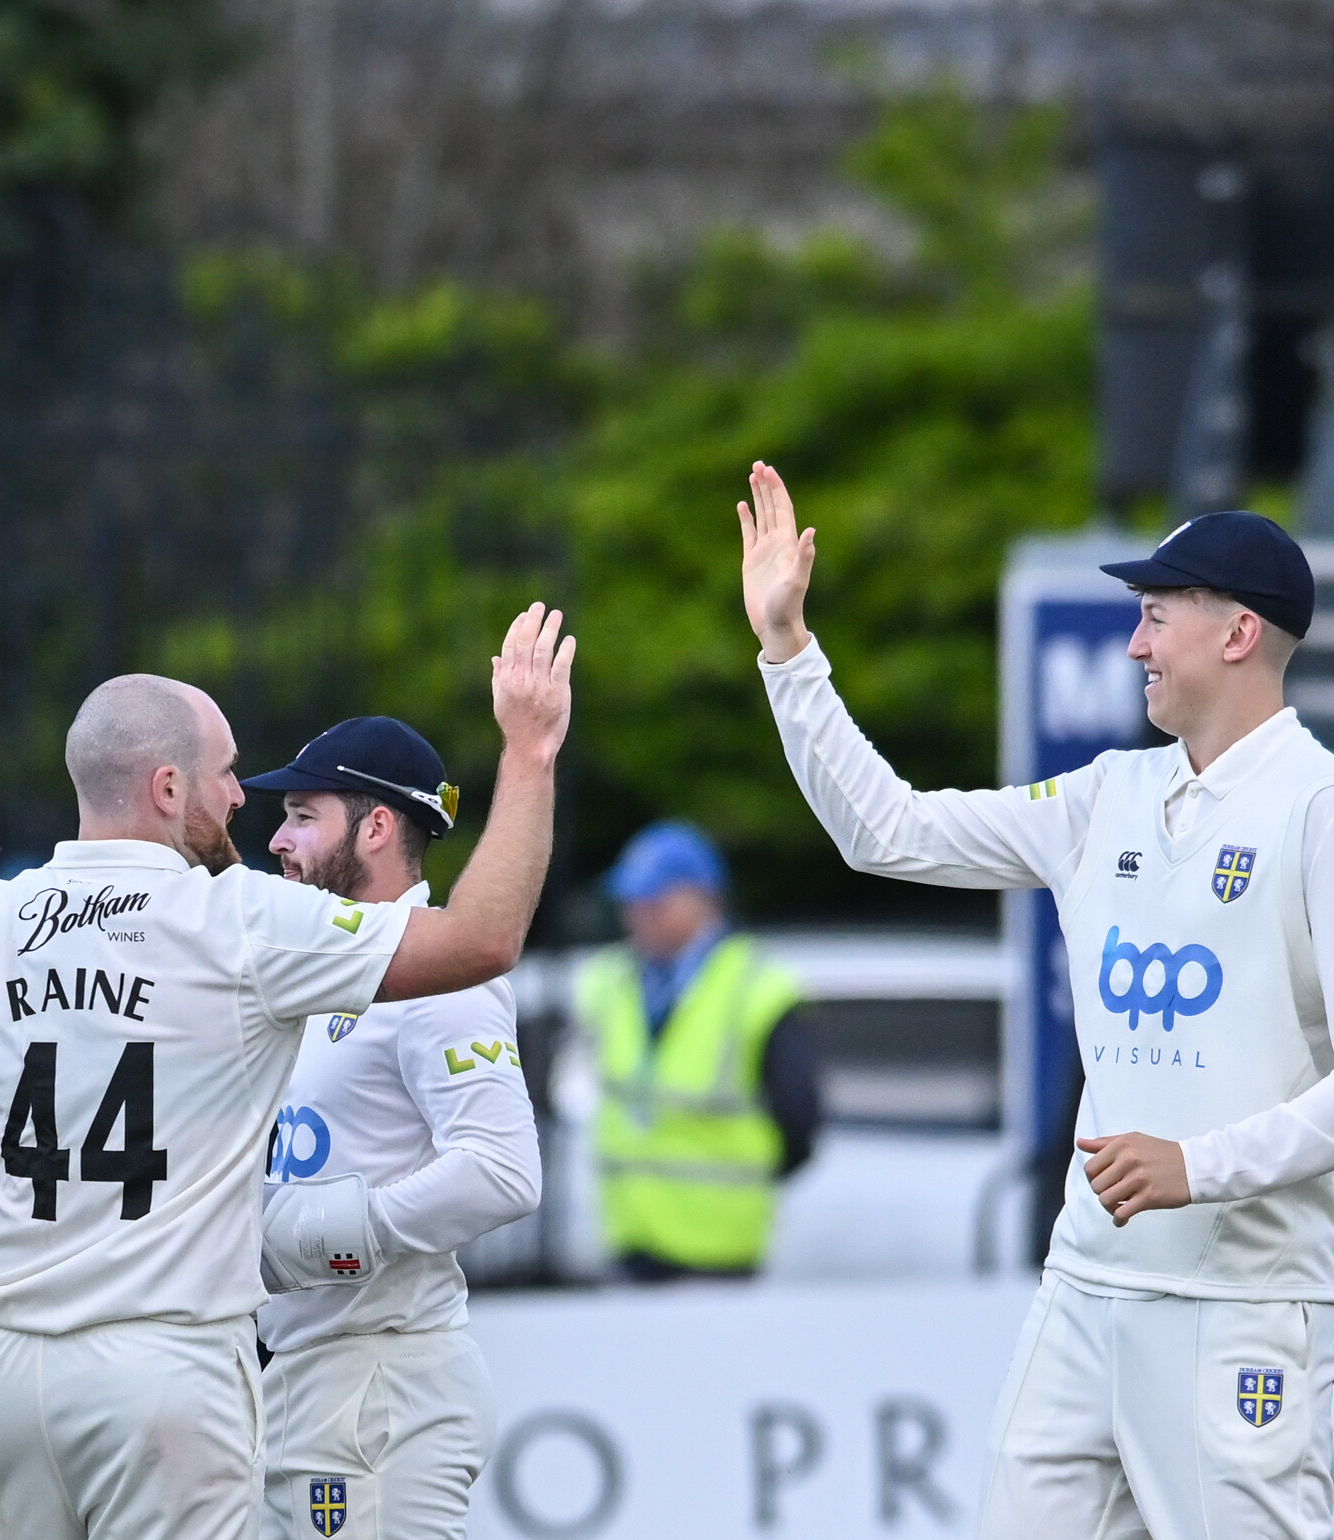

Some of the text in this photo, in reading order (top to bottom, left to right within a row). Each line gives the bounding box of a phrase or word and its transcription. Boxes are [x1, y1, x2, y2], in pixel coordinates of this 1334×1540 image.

[17, 884, 152, 957] Botham
[107, 931, 146, 943] WINES
[5, 967, 155, 1022] RAINE
[1093, 1045, 1206, 1069] VISUAL
[0, 1041, 169, 1222] 44
